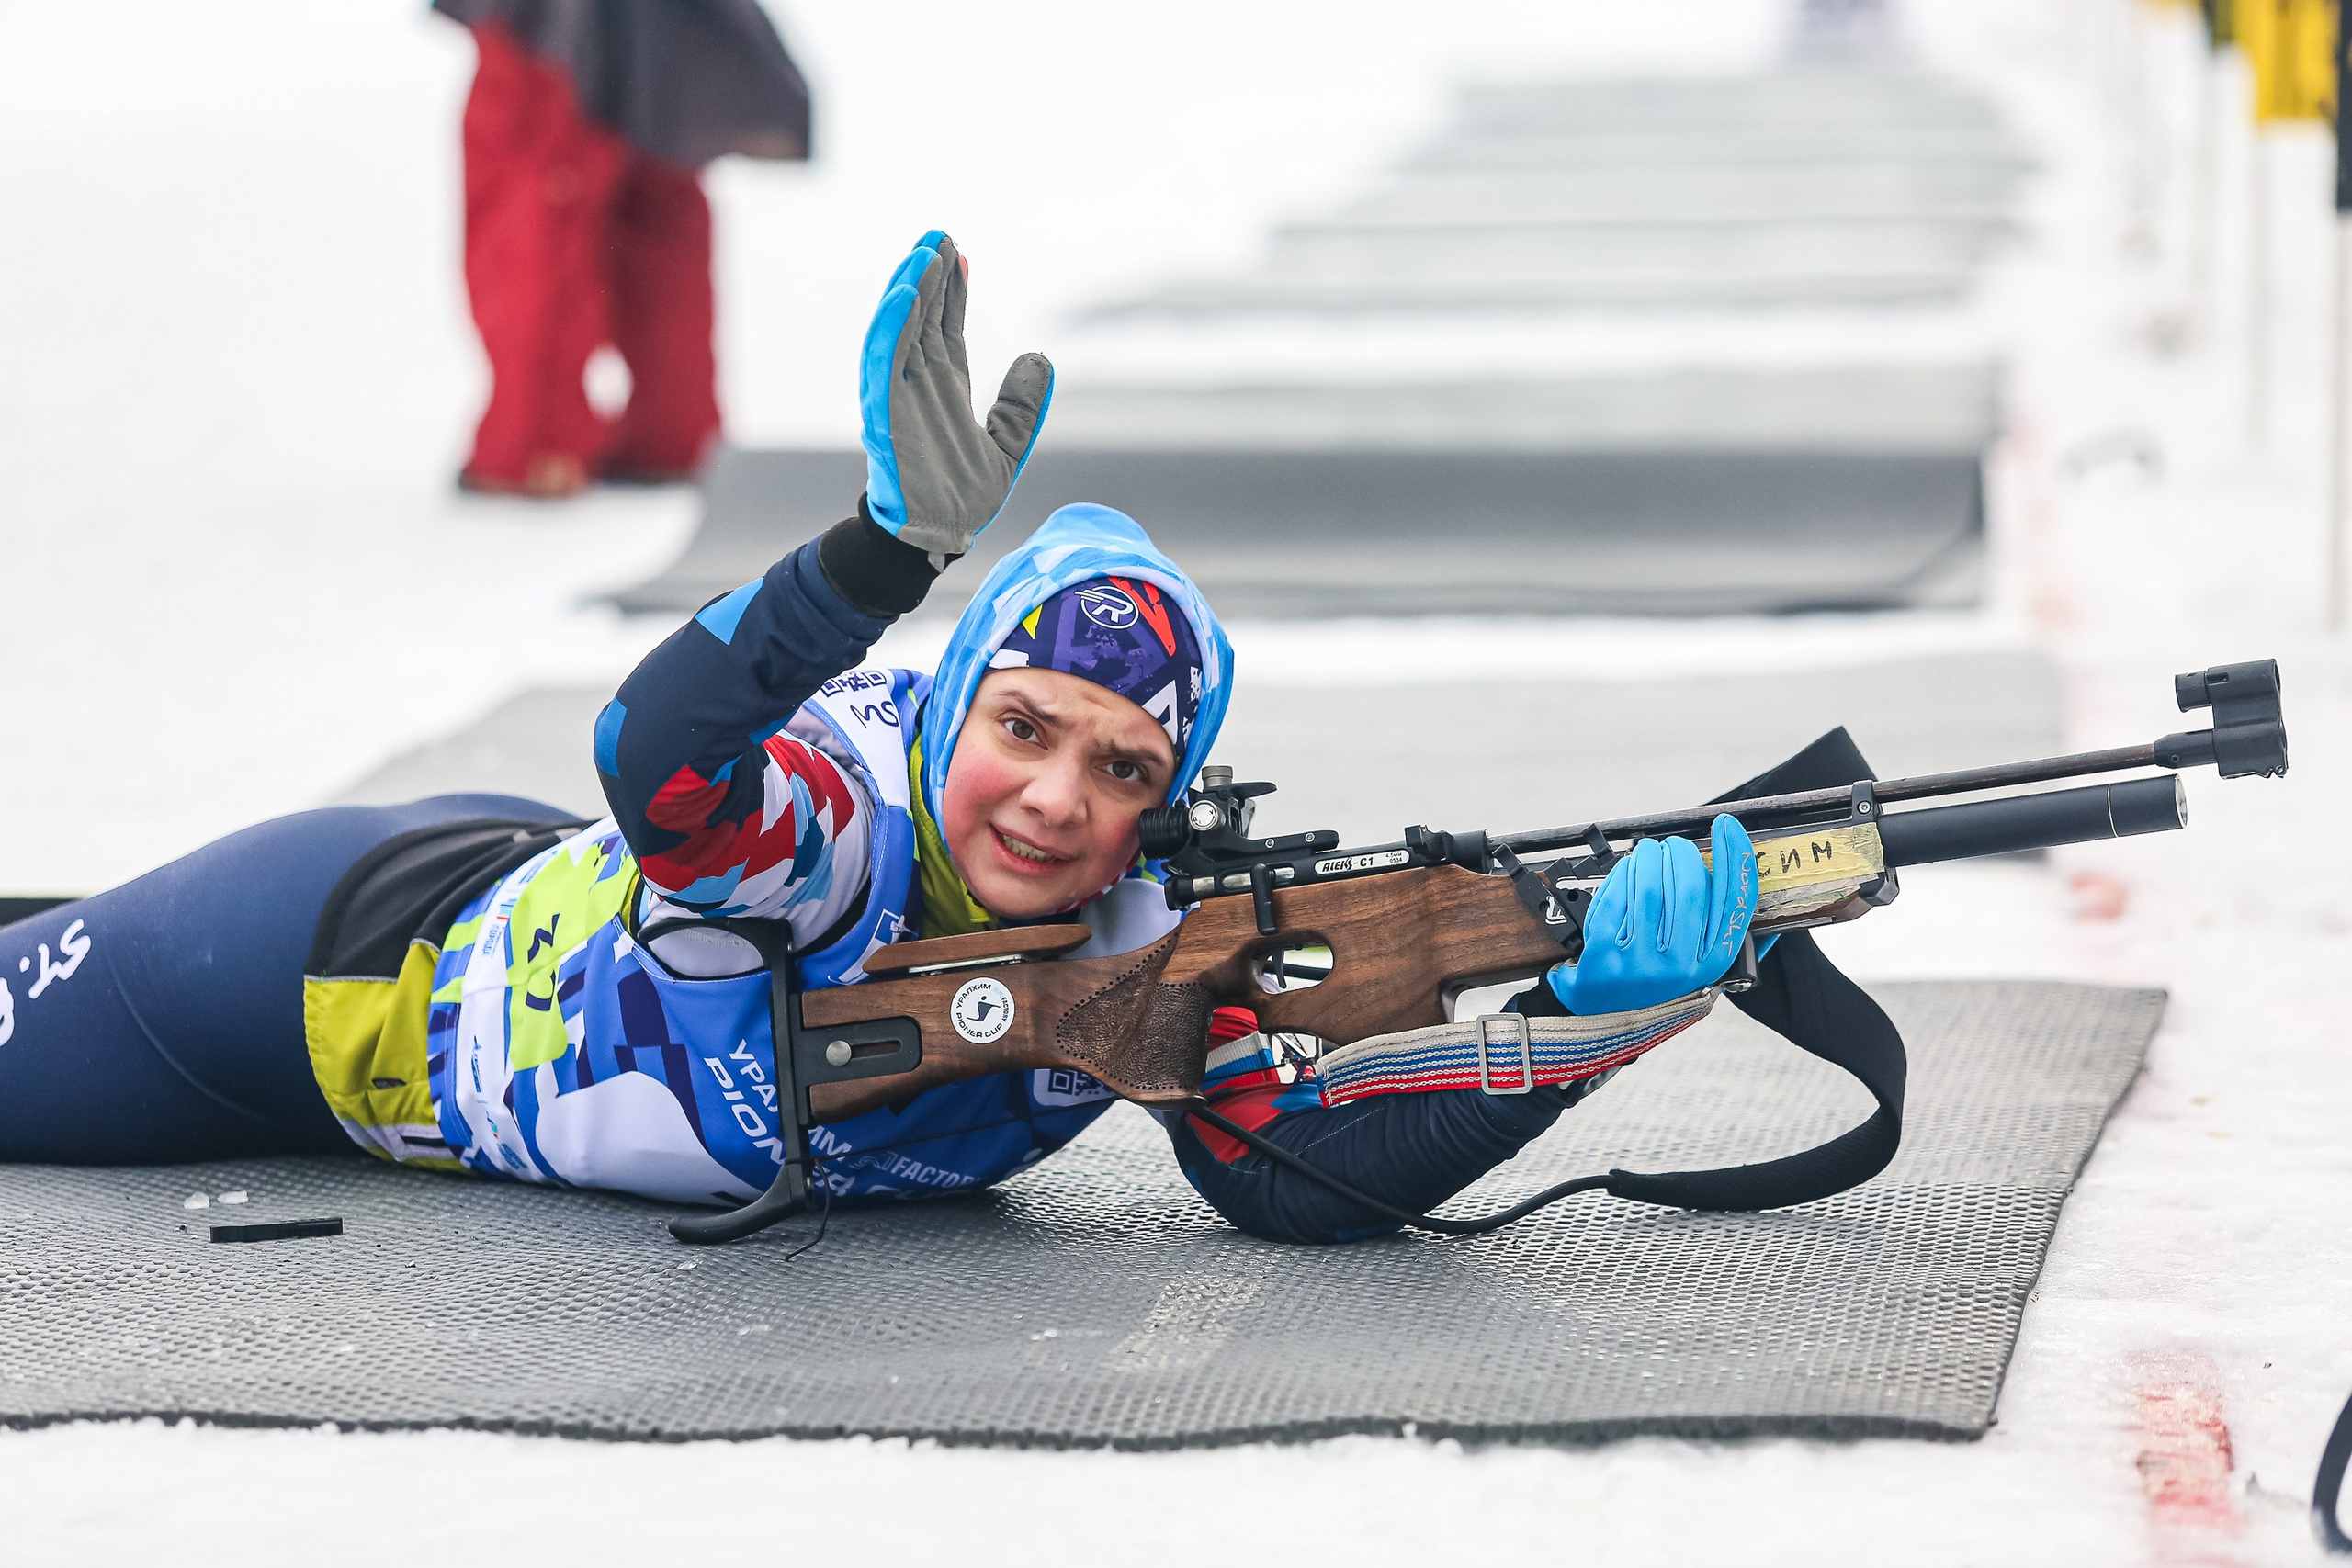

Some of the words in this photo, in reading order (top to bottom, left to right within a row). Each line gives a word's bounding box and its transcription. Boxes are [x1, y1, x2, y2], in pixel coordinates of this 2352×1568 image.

[956, 983, 992, 1009] УРАЛХИМ
[1001, 997, 1010, 1022] FACTORY
[956, 1012, 984, 1038] PIONER
[984, 1022, 1003, 1038] CUP
